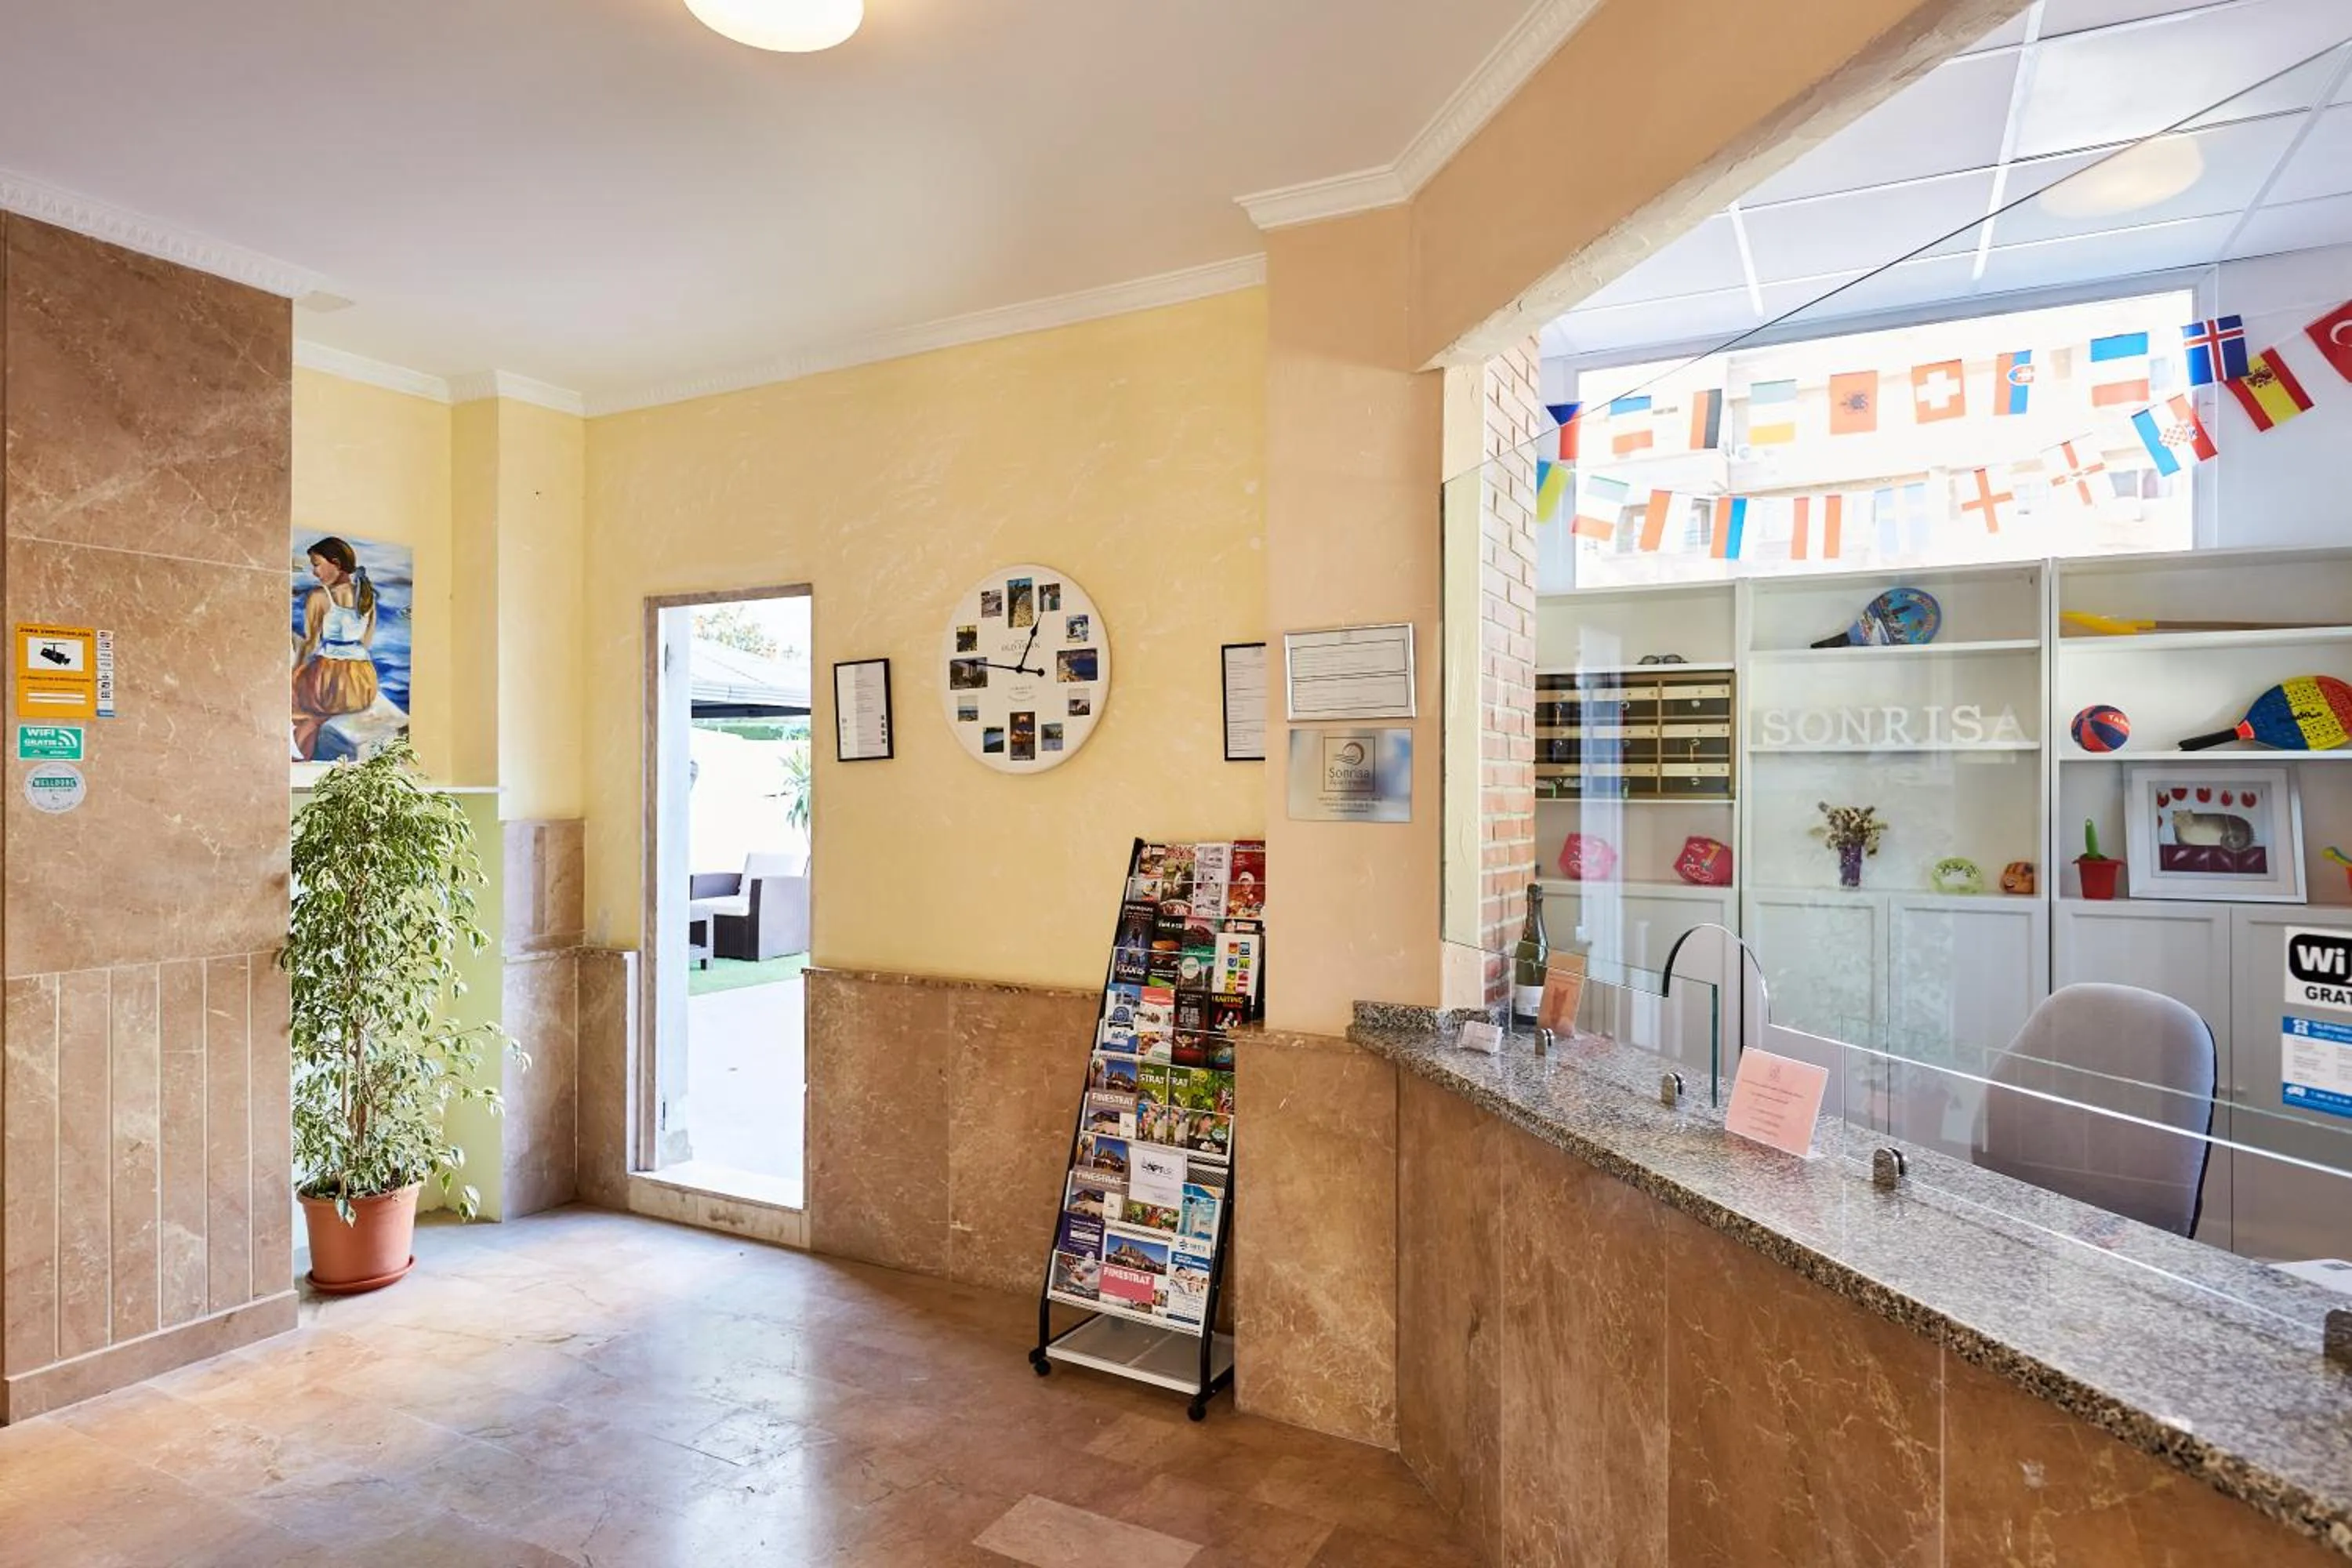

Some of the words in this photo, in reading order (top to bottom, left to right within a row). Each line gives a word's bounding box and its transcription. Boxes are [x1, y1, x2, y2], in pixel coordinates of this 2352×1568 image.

[1762, 704, 2030, 746] SONRISA
[26, 728, 56, 737] WIFI
[1329, 767, 1370, 779] Sonrisa
[1092, 1092, 1134, 1105] FINESTRAT
[1102, 1266, 1152, 1285] FINESTRAT
